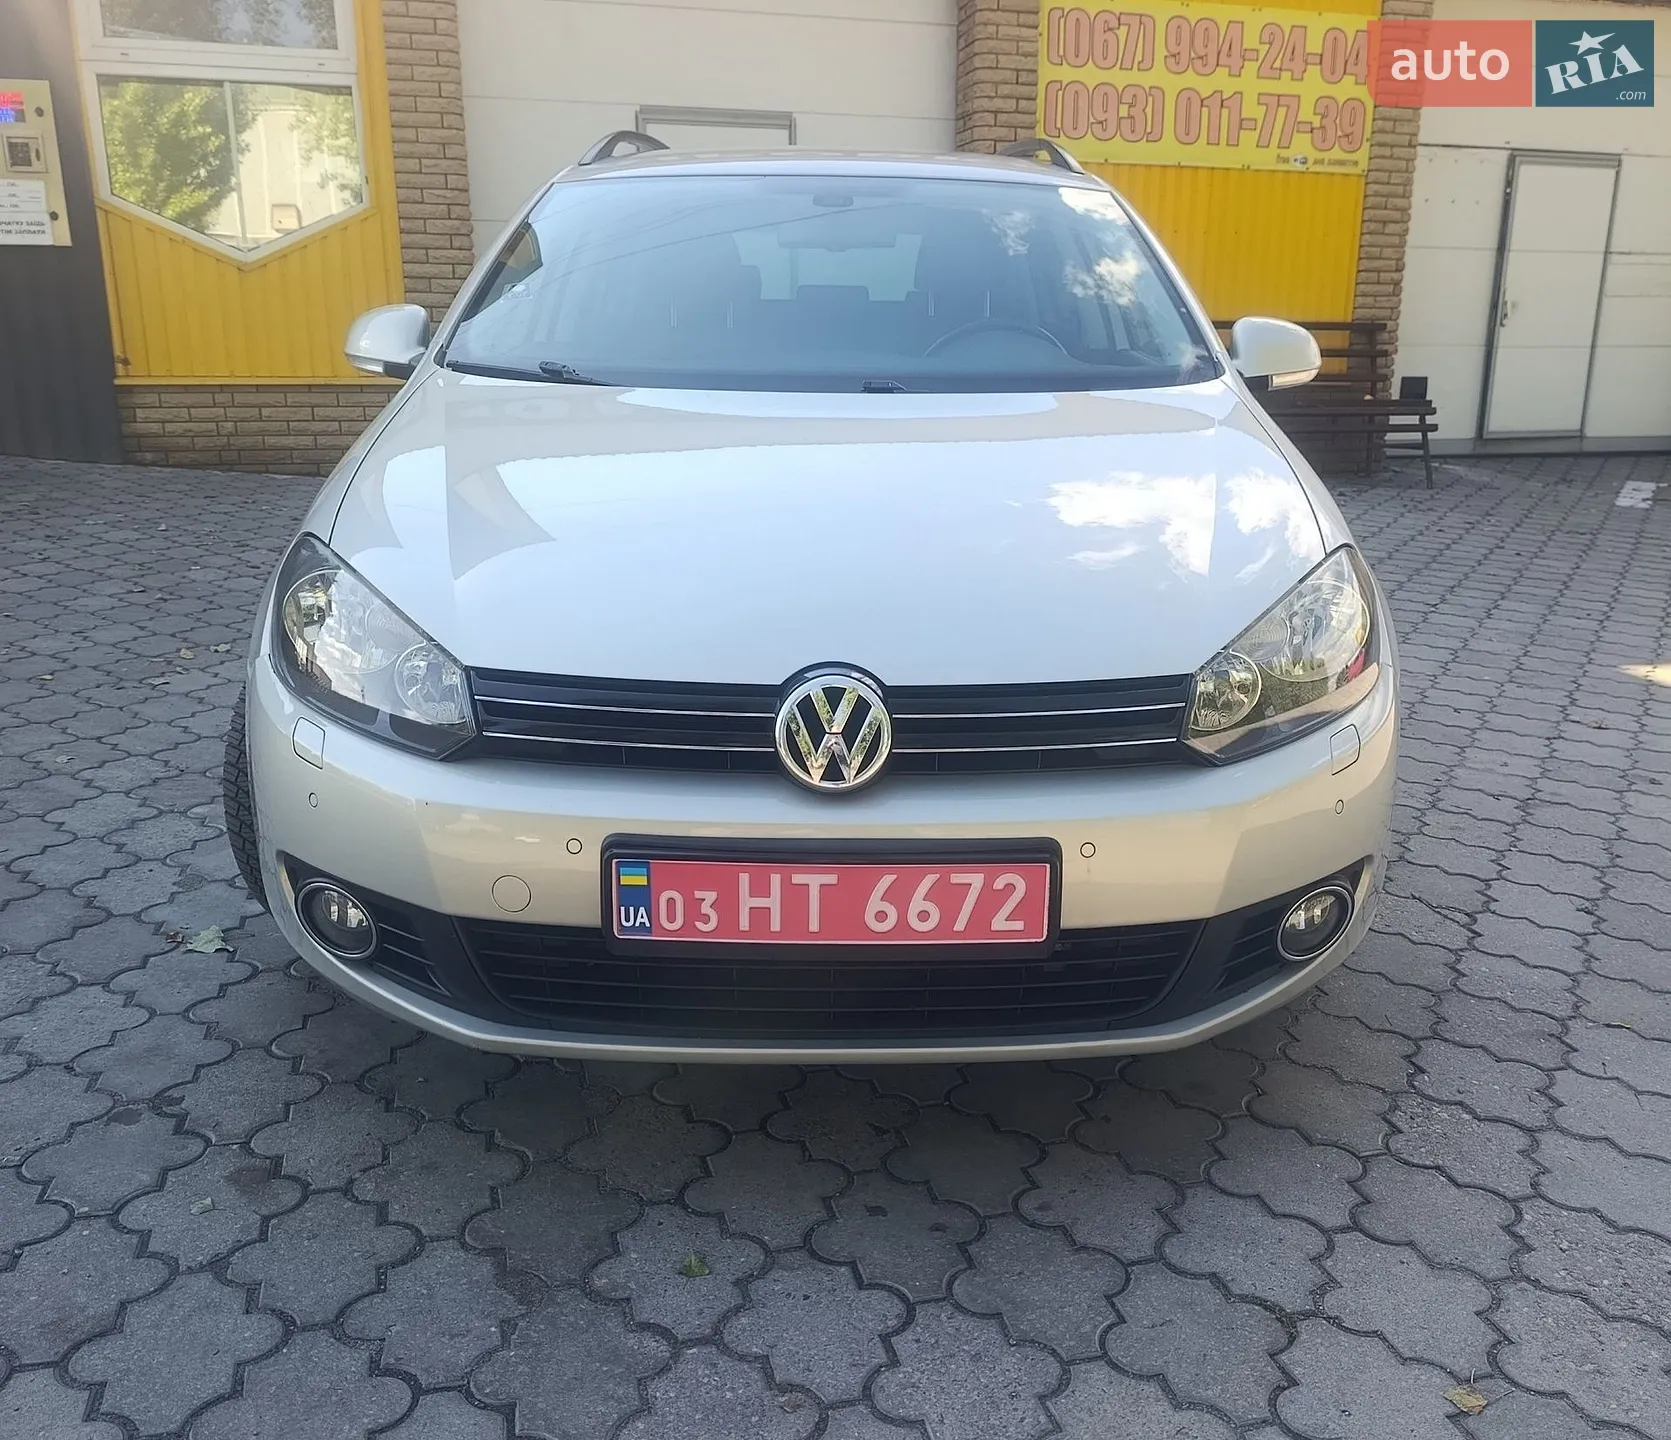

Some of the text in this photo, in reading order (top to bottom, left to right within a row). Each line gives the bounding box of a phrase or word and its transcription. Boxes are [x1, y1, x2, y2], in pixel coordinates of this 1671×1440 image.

[1047, 7, 1369, 86] (067) 994-24-04
[1043, 80, 1366, 152] (093) 011-77-39
[619, 906, 650, 928] UA
[657, 872, 1027, 934] 03 HT 6672
